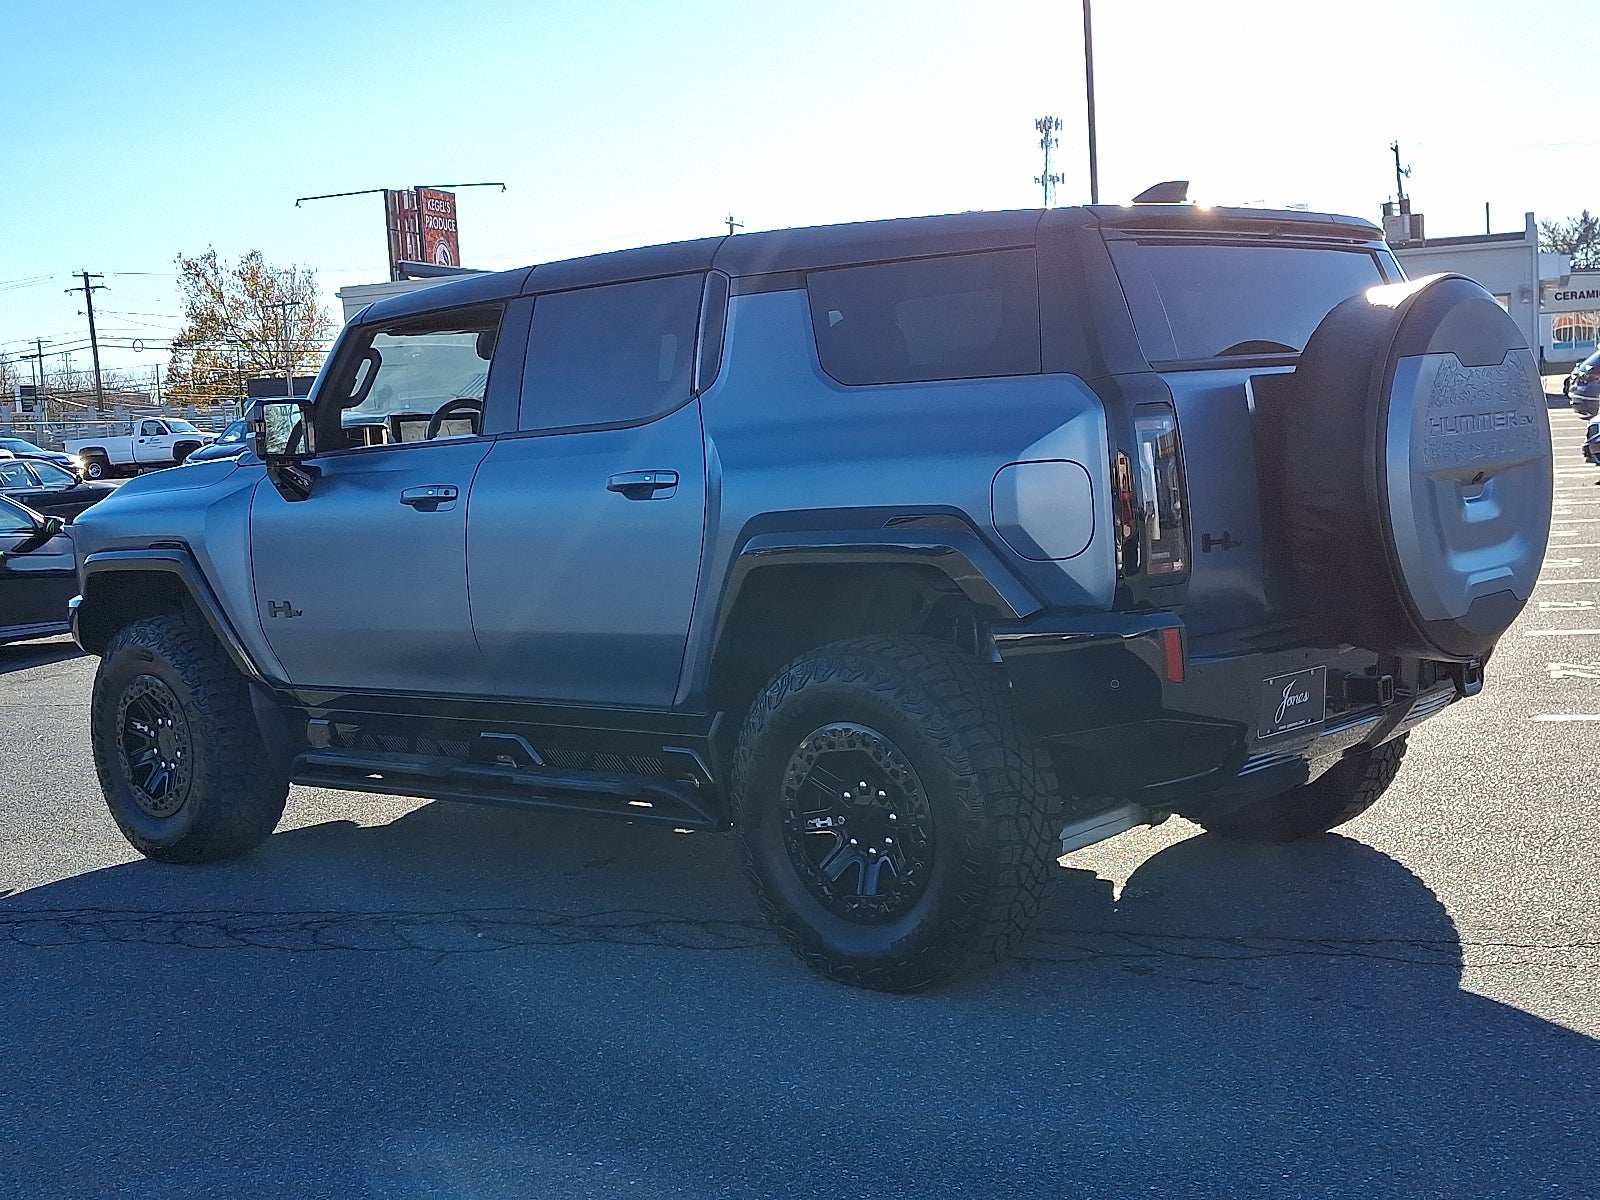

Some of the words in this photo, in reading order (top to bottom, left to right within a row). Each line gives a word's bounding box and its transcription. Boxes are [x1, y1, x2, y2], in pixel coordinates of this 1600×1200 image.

[427, 199, 451, 213] KEGEL'S
[425, 215, 456, 232] PRODUCE
[1554, 289, 1600, 301] CERAMI
[1429, 410, 1517, 438] HUMMER
[1274, 679, 1310, 724] Jones
